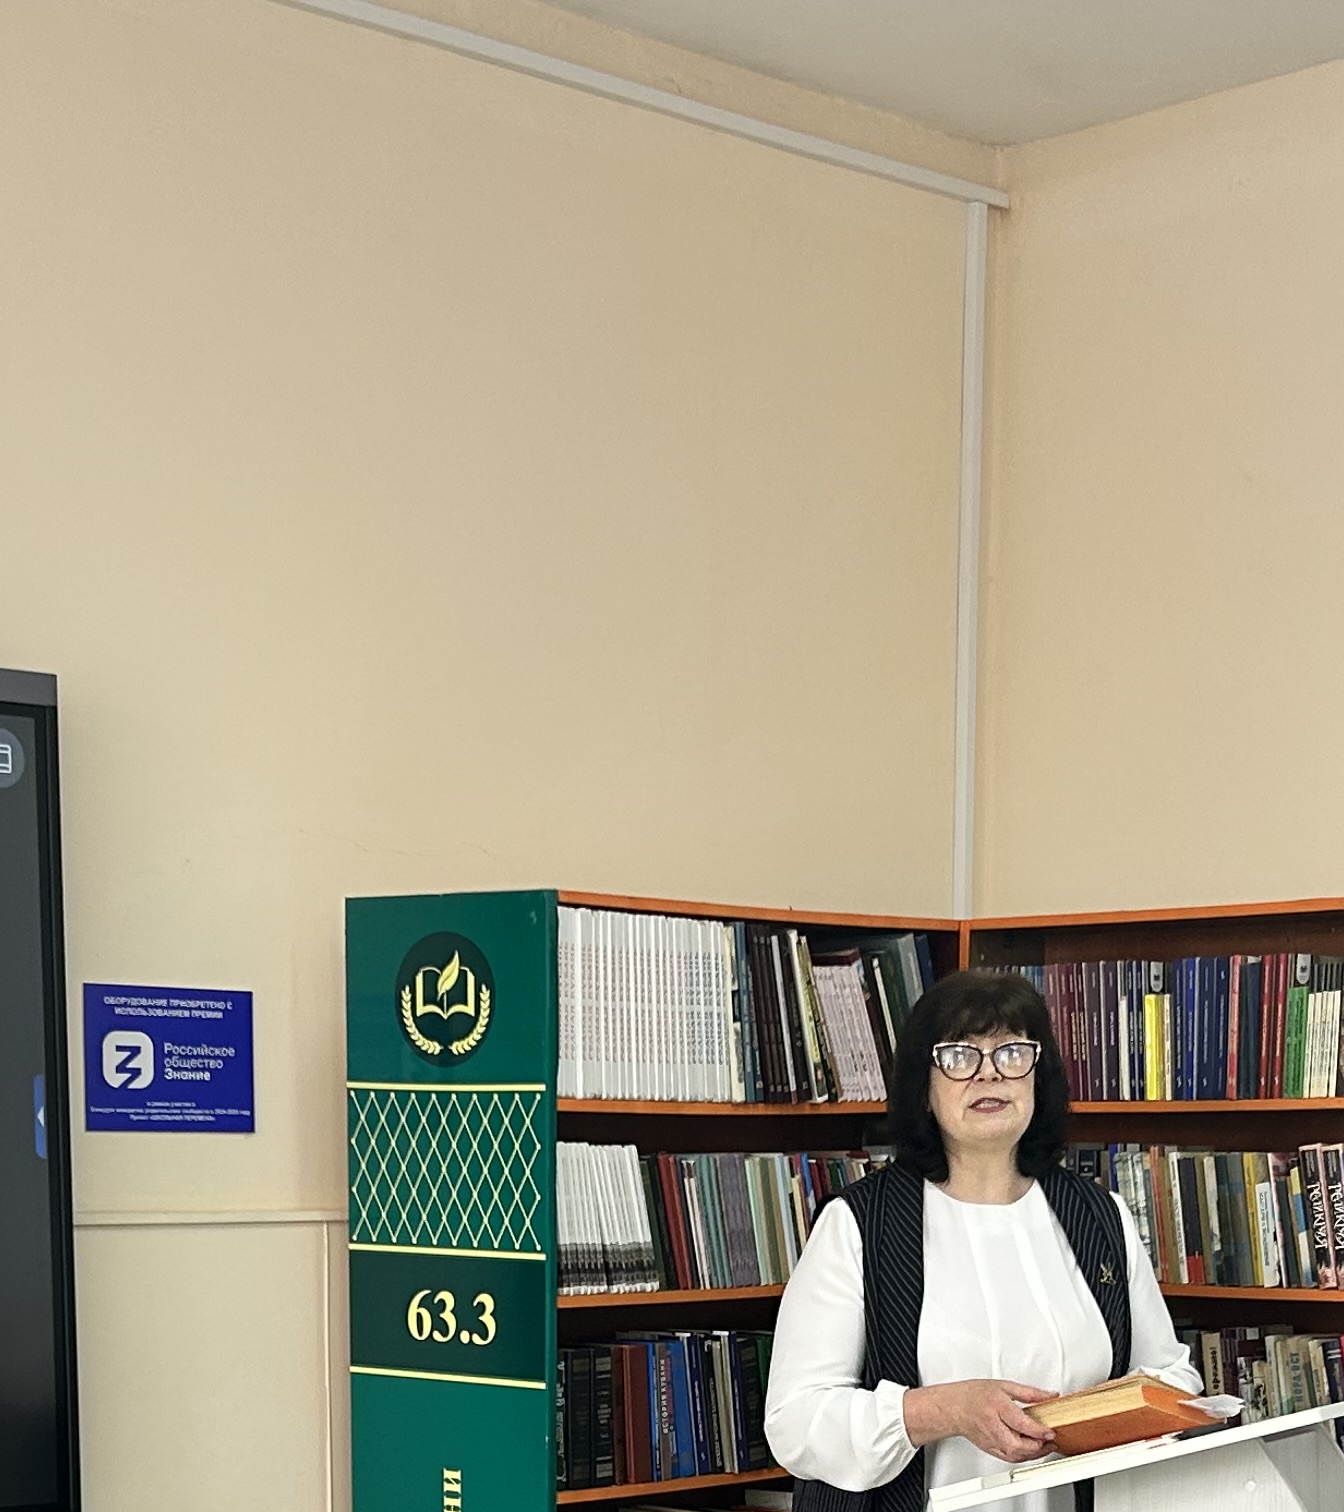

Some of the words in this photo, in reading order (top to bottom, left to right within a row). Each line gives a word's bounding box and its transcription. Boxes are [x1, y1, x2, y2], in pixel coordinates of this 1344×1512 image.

[164, 1042, 235, 1057] Российское
[164, 1058, 224, 1070] общество
[164, 1068, 210, 1080] Знание
[407, 1289, 496, 1345] 63.3
